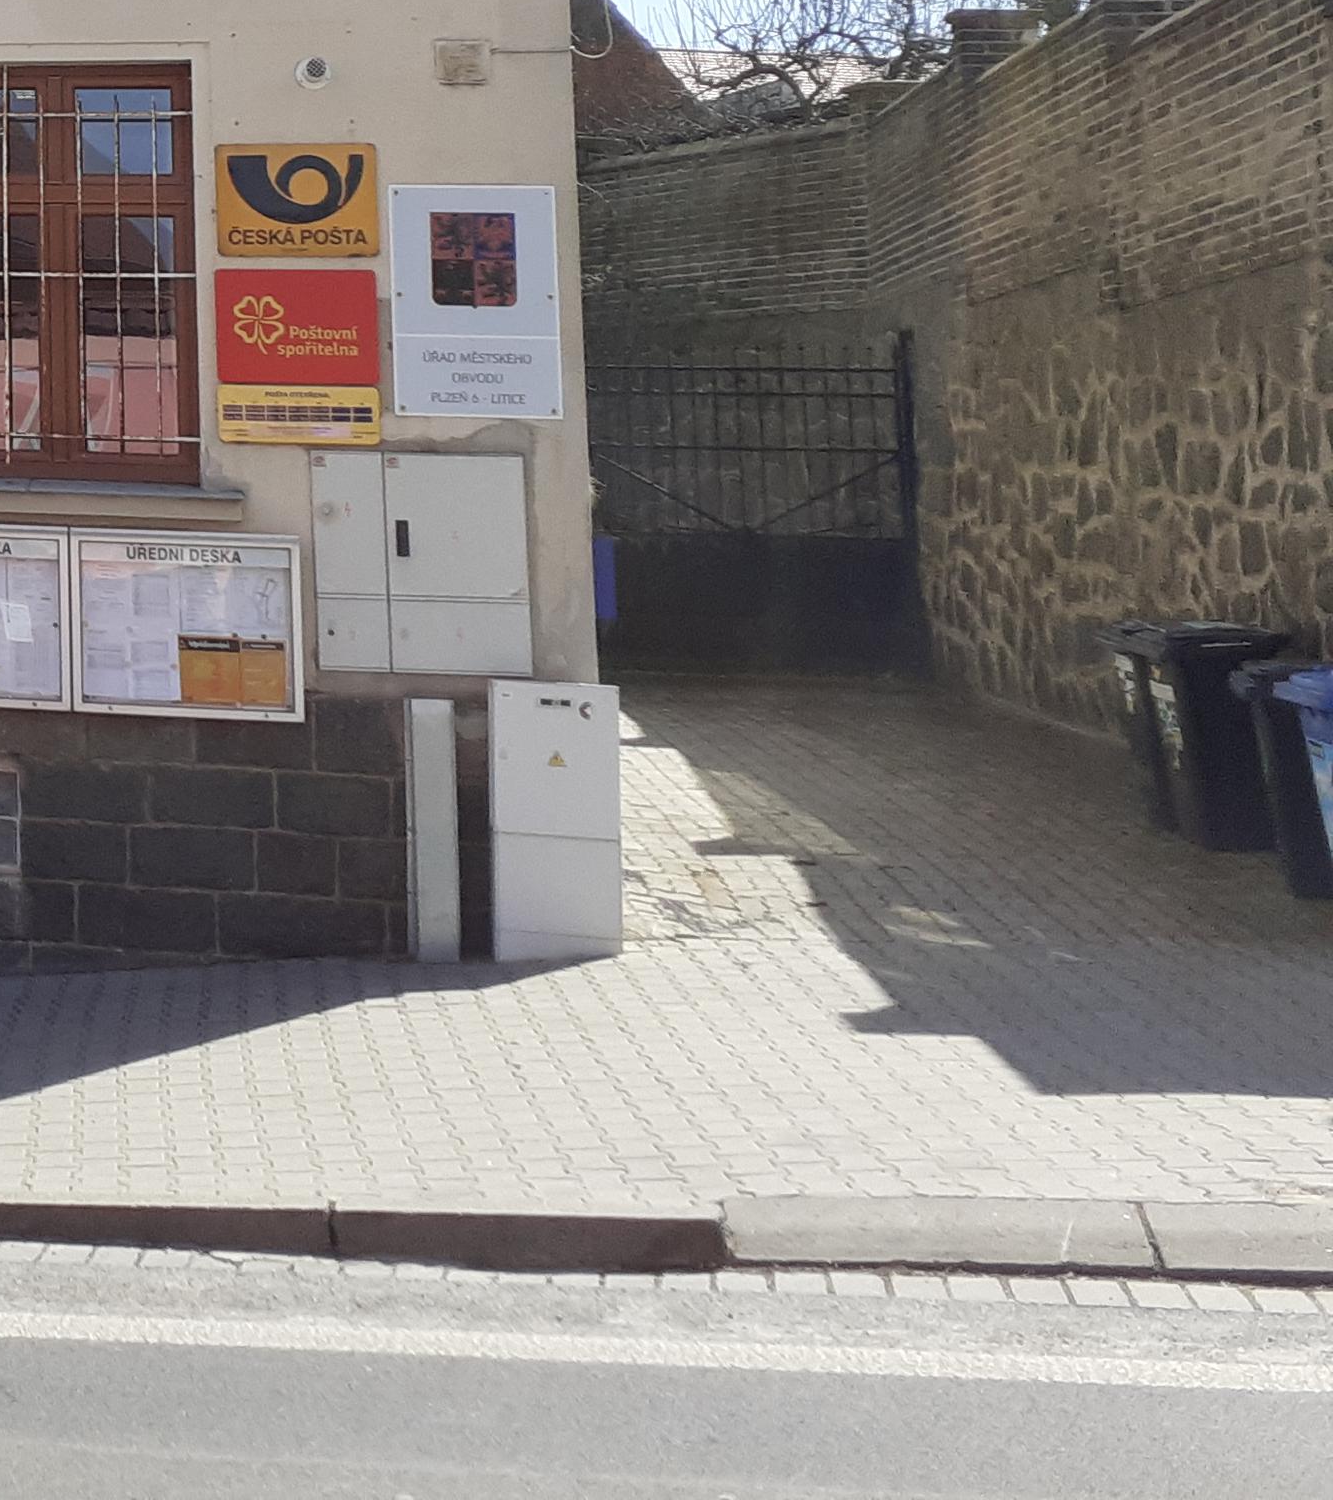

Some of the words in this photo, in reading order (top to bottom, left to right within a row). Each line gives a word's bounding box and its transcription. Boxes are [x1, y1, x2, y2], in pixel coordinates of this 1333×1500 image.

[227, 226, 296, 245] ČESKÁ
[300, 226, 368, 245] POŠTA
[289, 324, 358, 341] Poštovní
[277, 342, 359, 358] spořitelna
[422, 350, 456, 363] ÚŘAD
[452, 372, 504, 384] OBVODU
[430, 391, 468, 403] PLZEŇ
[491, 393, 526, 405] LITICE
[190, 548, 242, 564] DESKA
